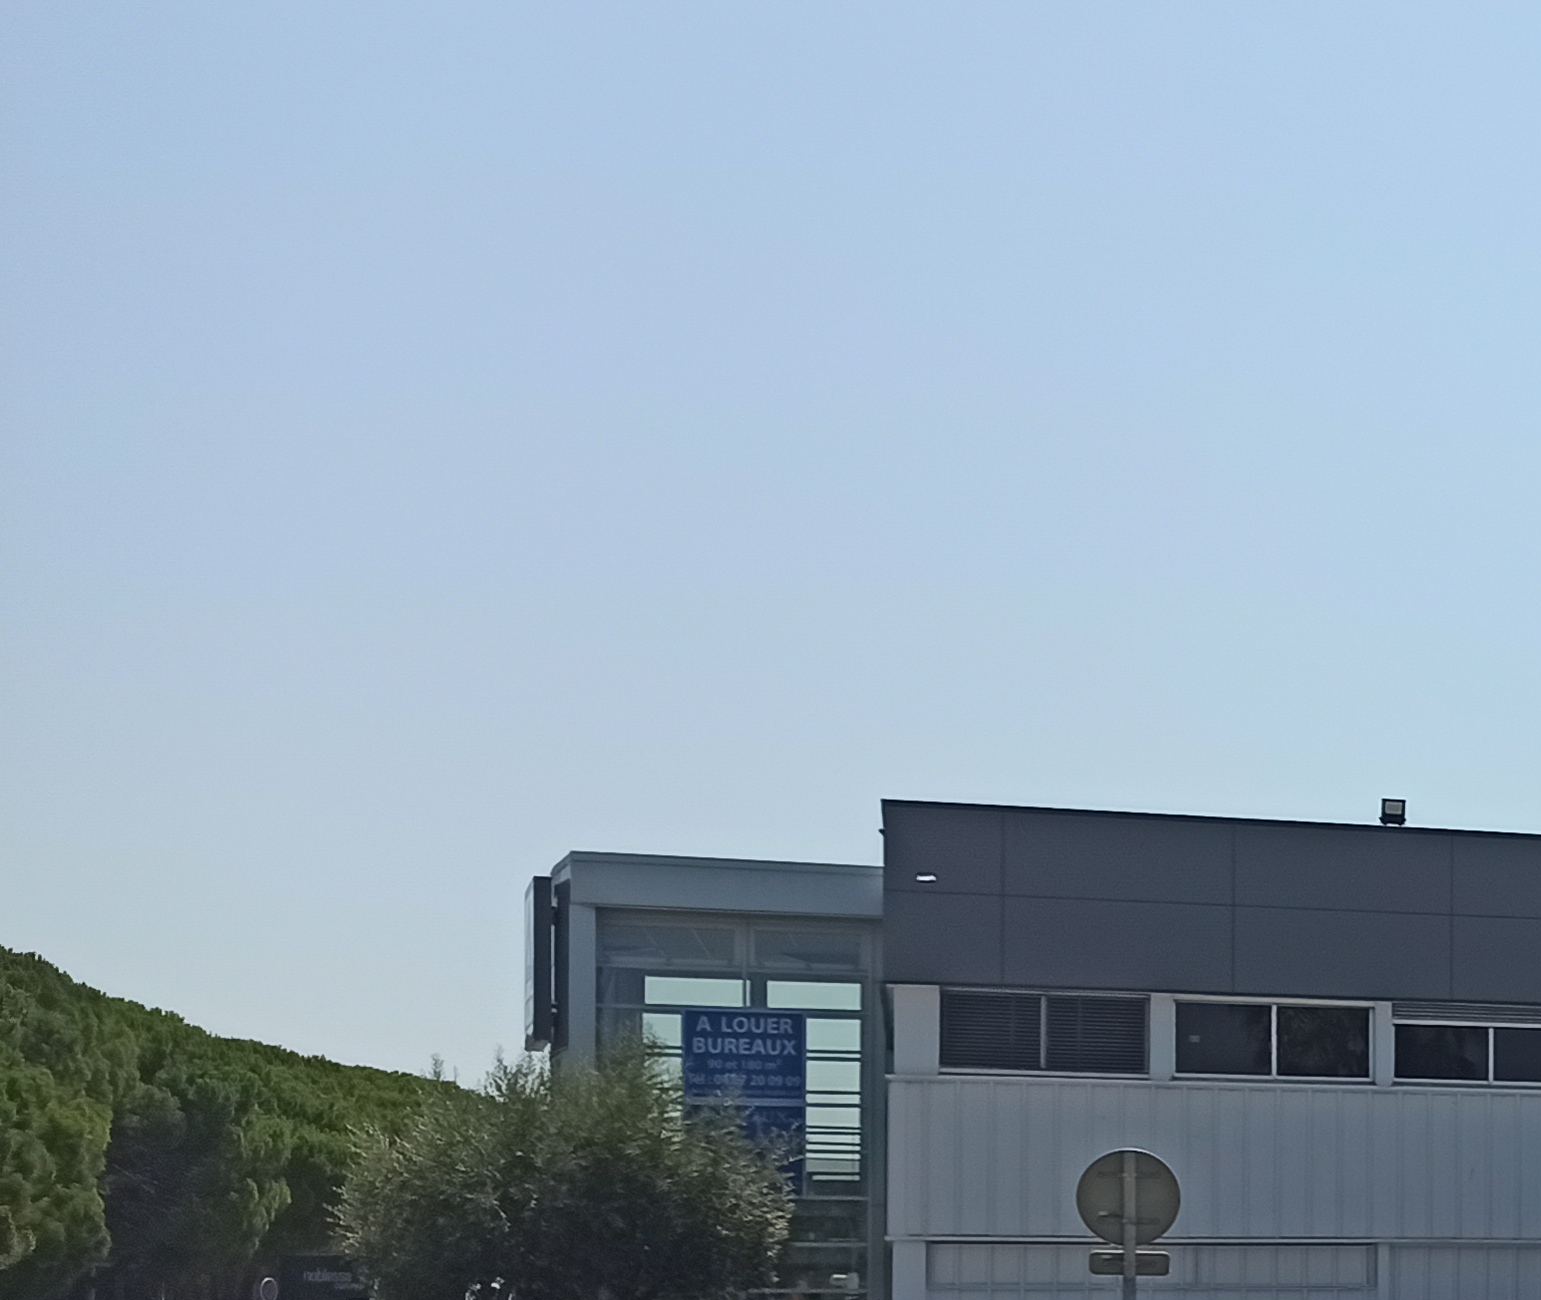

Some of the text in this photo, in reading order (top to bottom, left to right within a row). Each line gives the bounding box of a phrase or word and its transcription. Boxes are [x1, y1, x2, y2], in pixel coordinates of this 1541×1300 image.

[696, 1016, 793, 1034] A LOUER
[692, 1037, 797, 1055] BUREAUX
